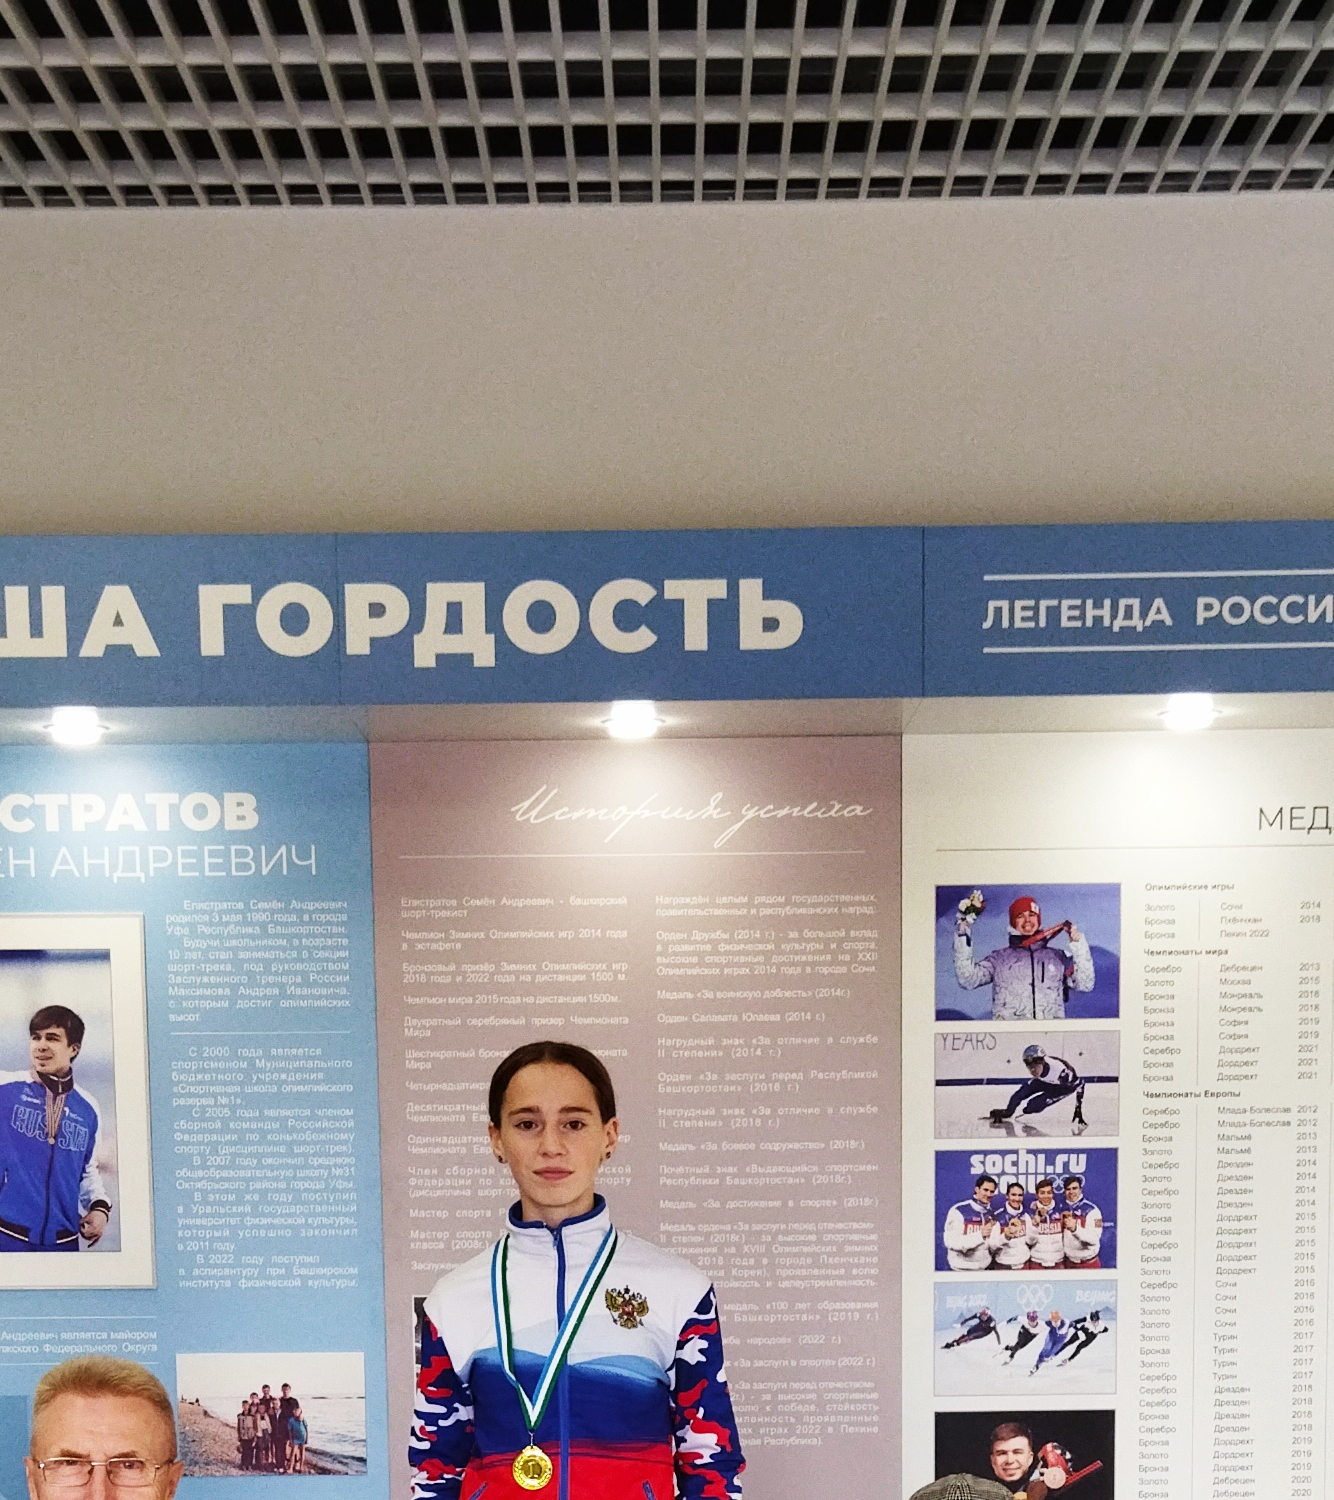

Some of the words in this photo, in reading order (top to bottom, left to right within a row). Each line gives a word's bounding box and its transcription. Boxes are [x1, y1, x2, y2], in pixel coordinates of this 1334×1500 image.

[982, 596, 1173, 633] ЛЕГЕНДА
[198, 577, 805, 670] ГОРДОСТЬ
[510, 785, 731, 843] История
[741, 799, 872, 848] успеха
[51, 844, 317, 883] АНДРЕЕВИЧ
[1145, 883, 1208, 892] Олимпийские
[184, 900, 244, 911] Елистратов
[250, 900, 284, 909] Семён
[290, 900, 347, 911] Андреевич
[167, 913, 209, 924] родился
[222, 914, 242, 922] мая
[247, 913, 270, 922] 1990
[198, 924, 260, 937] Республика
[449, 930, 485, 939] Зимних
[579, 929, 601, 938] 2014
[184, 937, 220, 949] Будучи
[168, 950, 179, 959] 10
[238, 951, 297, 959] заниматься
[313, 950, 348, 960] секции
[244, 963, 263, 972] под
[272, 962, 349, 973] руководством
[501, 962, 537, 971] Зимних
[168, 974, 248, 985] Заслуженного
[256, 975, 301, 985] тренера
[310, 973, 349, 983] России
[403, 973, 426, 983] 2018
[466, 973, 489, 983] 2022
[592, 972, 613, 982] 1500
[168, 986, 230, 995] Максимова
[238, 986, 279, 996] Андрея
[182, 1000, 228, 1009] которым
[237, 999, 273, 1008] достиг
[280, 999, 351, 1007] олимпийских
[658, 1013, 688, 1024] Орден
[692, 1013, 738, 1023] Салавата
[743, 1013, 780, 1022] Юлаева
[658, 1036, 714, 1048] Нагрудный
[840, 1034, 878, 1046] службе
[1143, 1090, 1201, 1100] Чемпионаты
[1204, 1090, 1240, 1099] Европы
[970, 1148, 1087, 1175] sochi.ru
